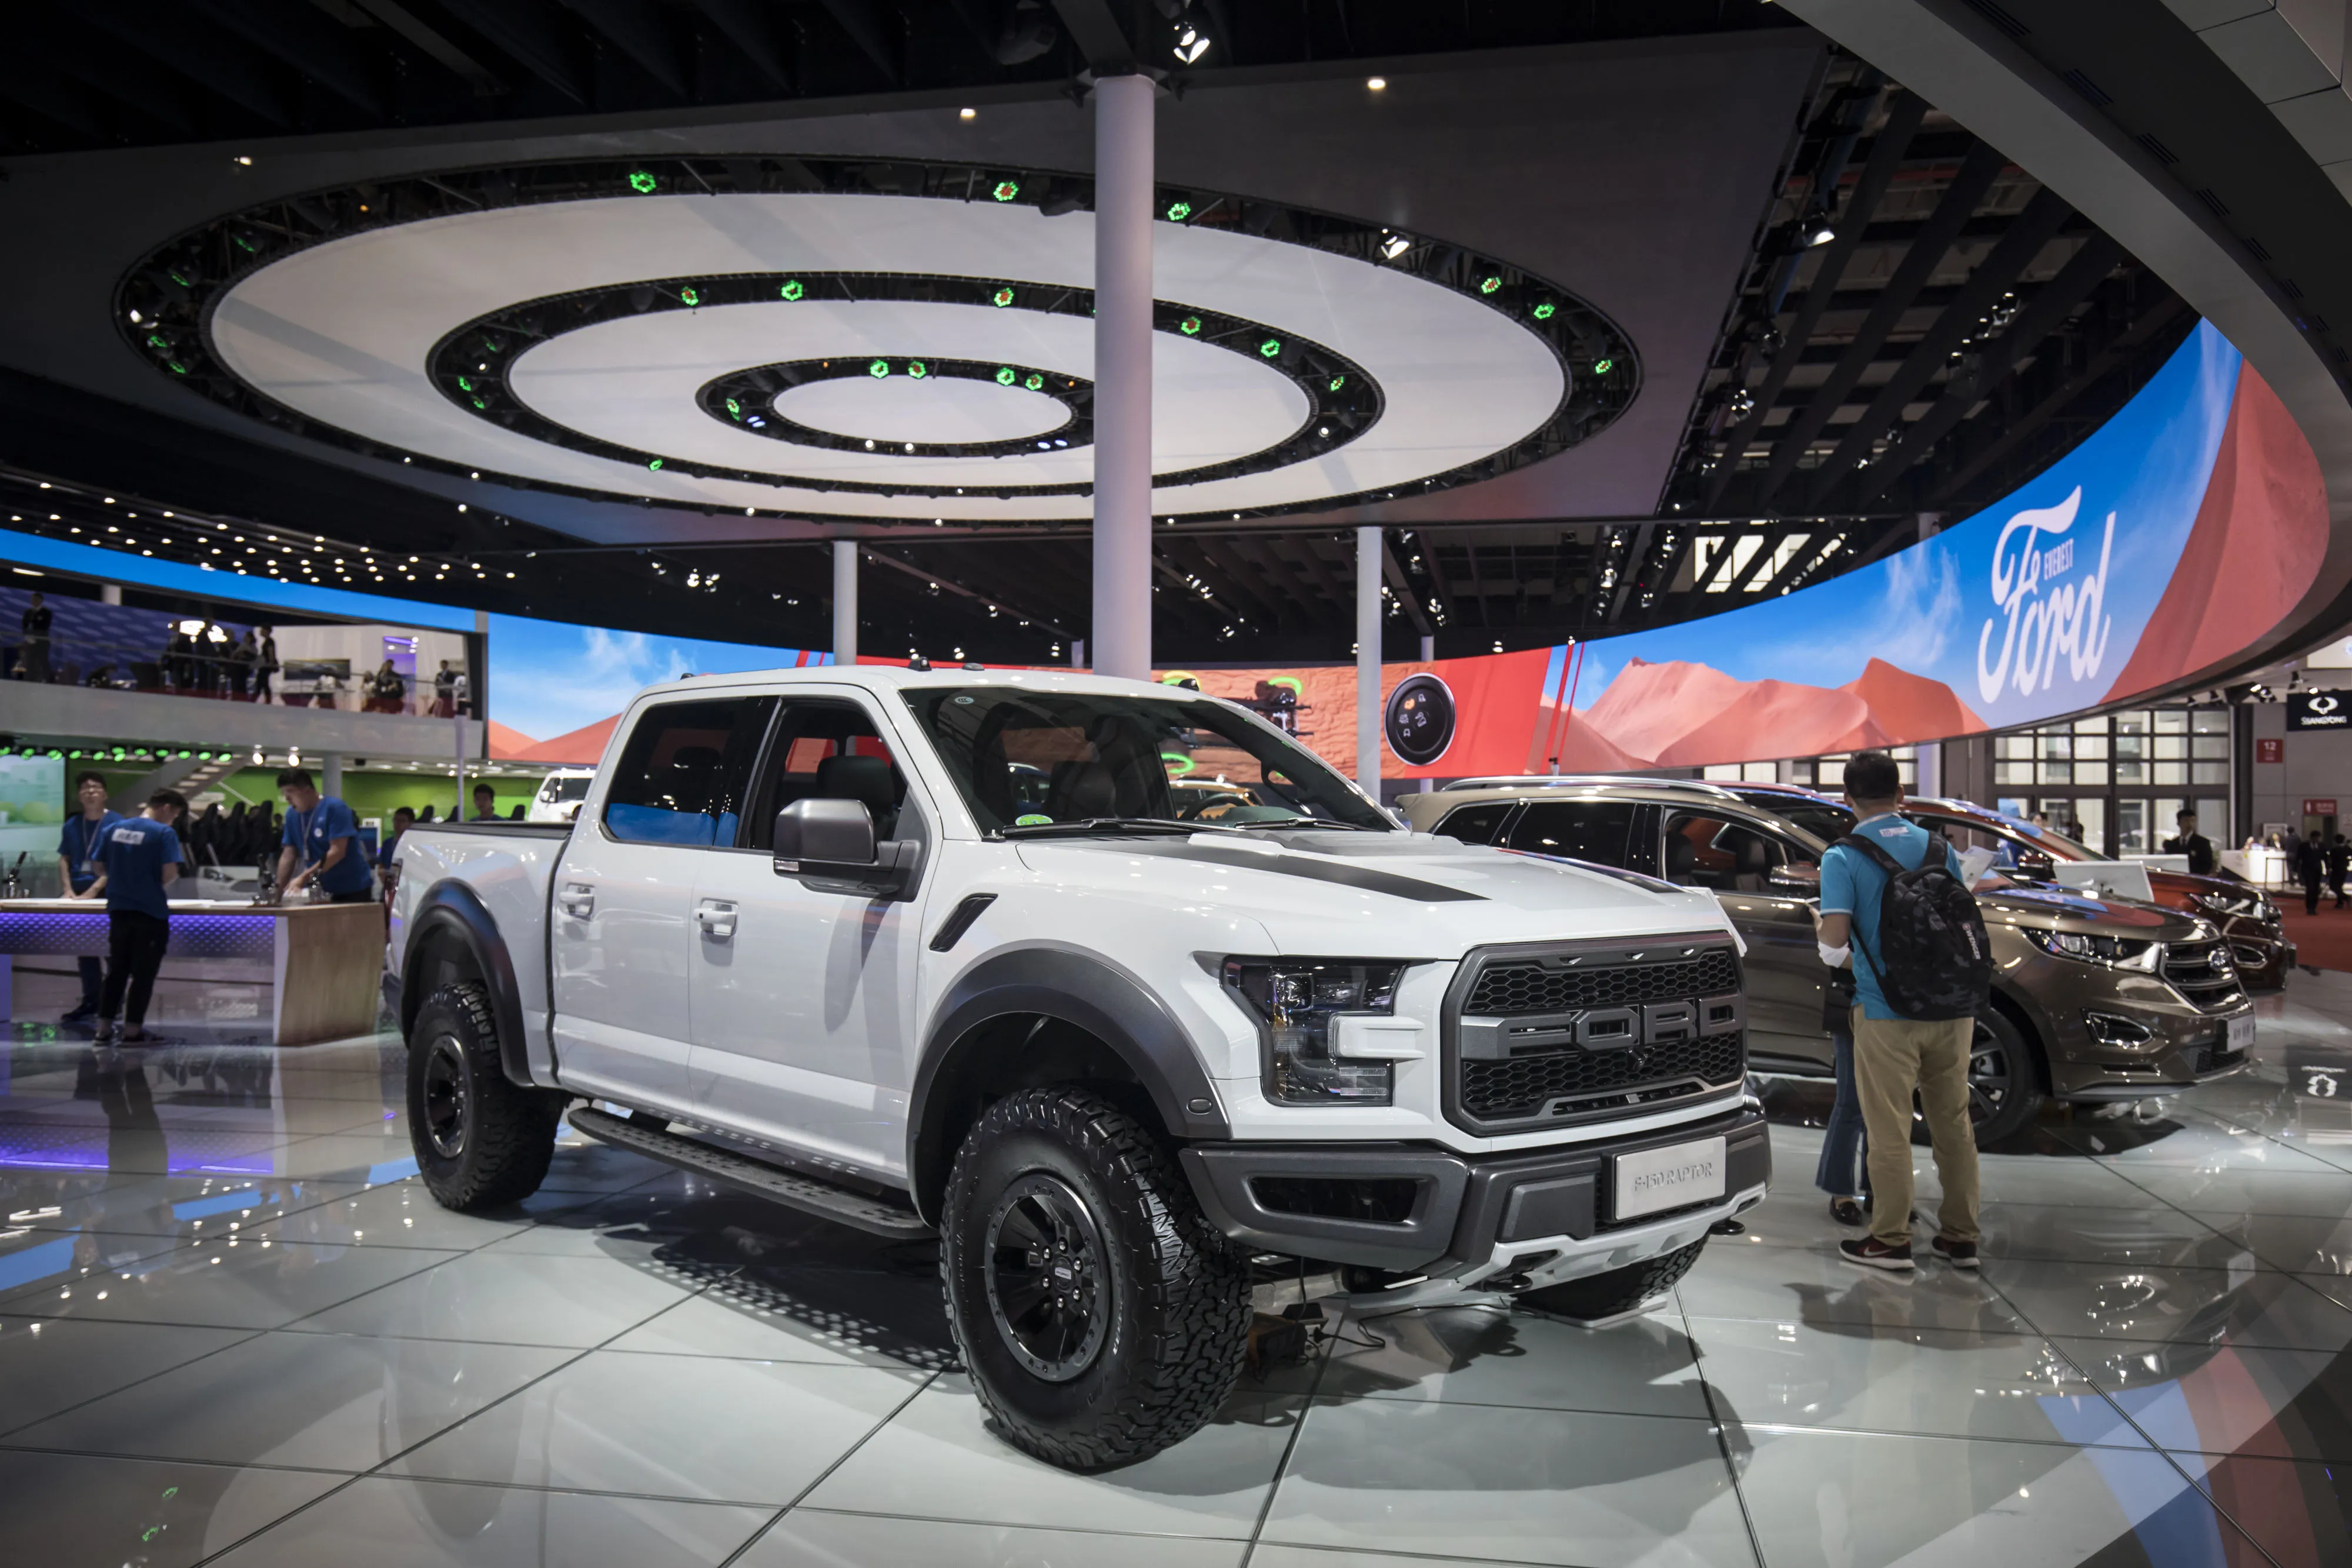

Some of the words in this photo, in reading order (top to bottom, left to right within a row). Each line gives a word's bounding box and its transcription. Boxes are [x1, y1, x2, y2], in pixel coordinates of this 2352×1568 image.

[2044, 537, 2074, 581] EVEREST
[2264, 741, 2276, 751] 12
[1966, 929, 1981, 959] WENGER
[1494, 989, 1741, 1060] FORD
[1634, 1171, 1665, 1192] F-150
[1666, 1162, 1712, 1185] RAPTOR
